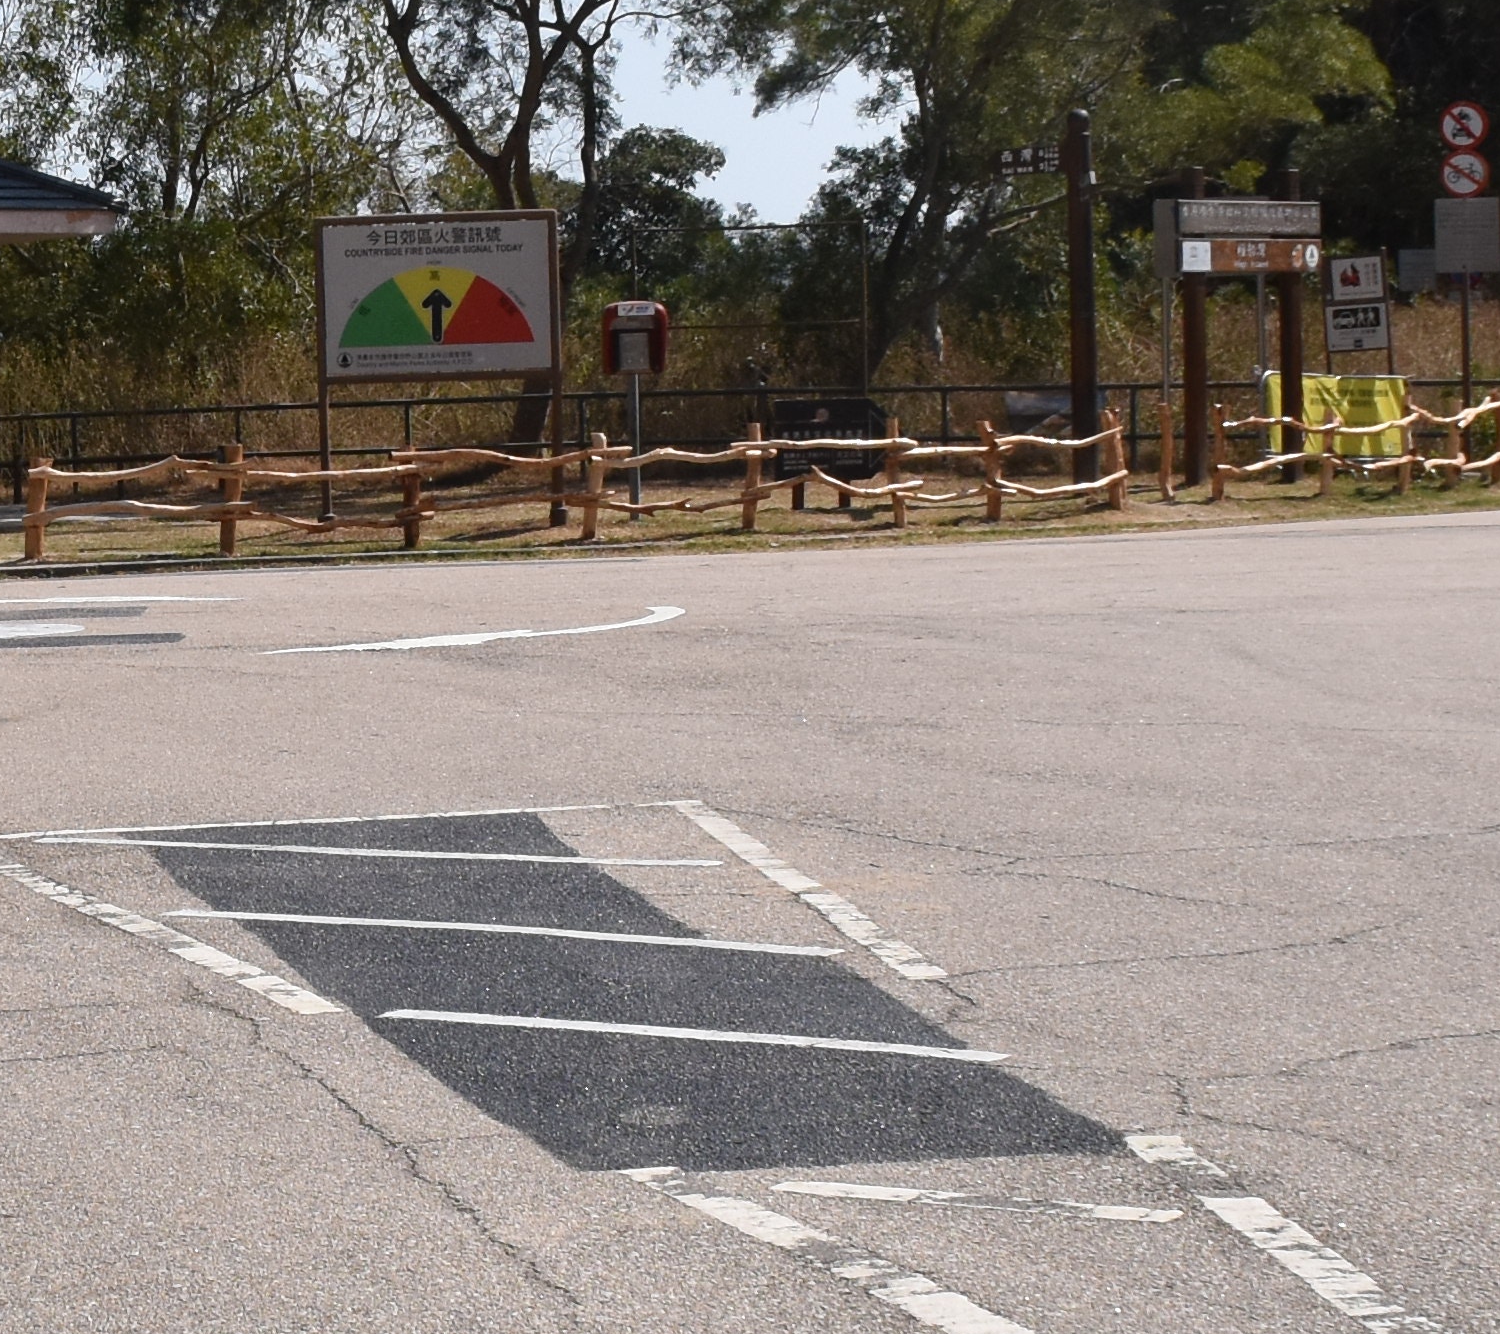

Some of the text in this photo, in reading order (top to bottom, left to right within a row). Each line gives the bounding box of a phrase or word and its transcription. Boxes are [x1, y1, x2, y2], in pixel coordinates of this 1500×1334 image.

[366, 226, 502, 245] 今日郊區火警訊號
[344, 243, 523, 258] COUNTRYSIDE FIRE DANGER SIGNAL TODAY
